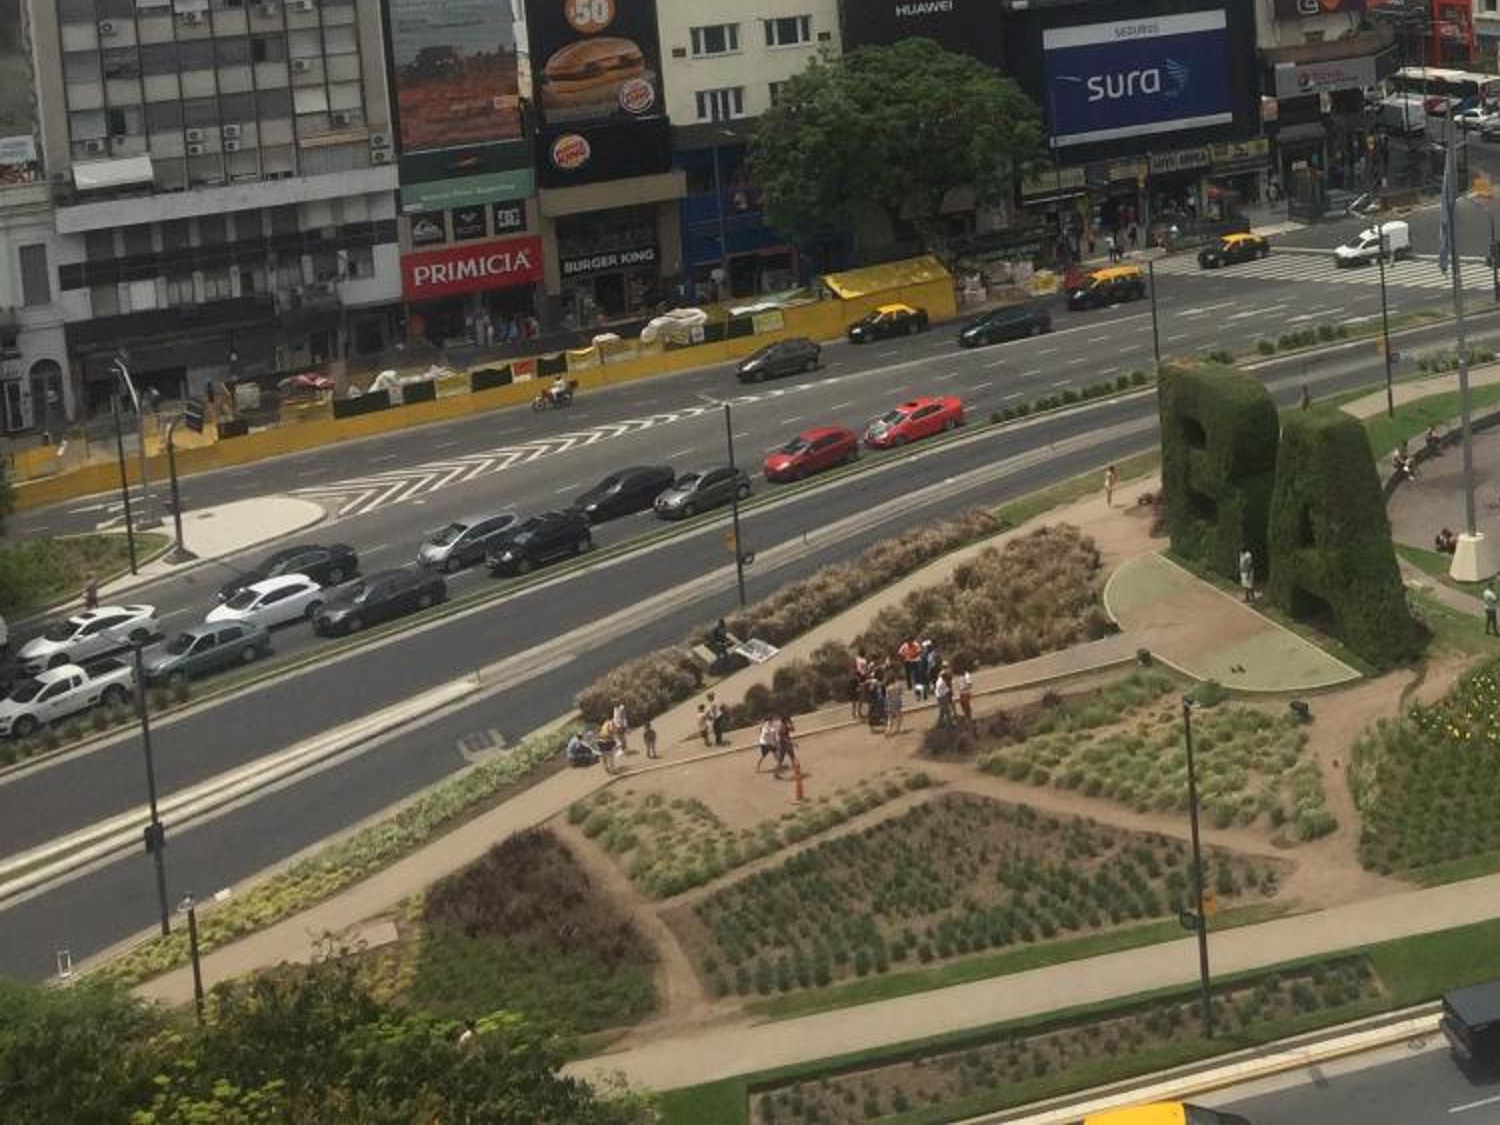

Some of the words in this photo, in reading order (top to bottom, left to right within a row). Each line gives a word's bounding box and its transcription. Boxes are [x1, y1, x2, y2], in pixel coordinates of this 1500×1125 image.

[895, 0, 954, 17] HUAWEI
[1086, 67, 1161, 102] sura
[414, 251, 531, 286] PRIMICIA
[563, 255, 617, 274] BURGER
[621, 249, 655, 267] KING
